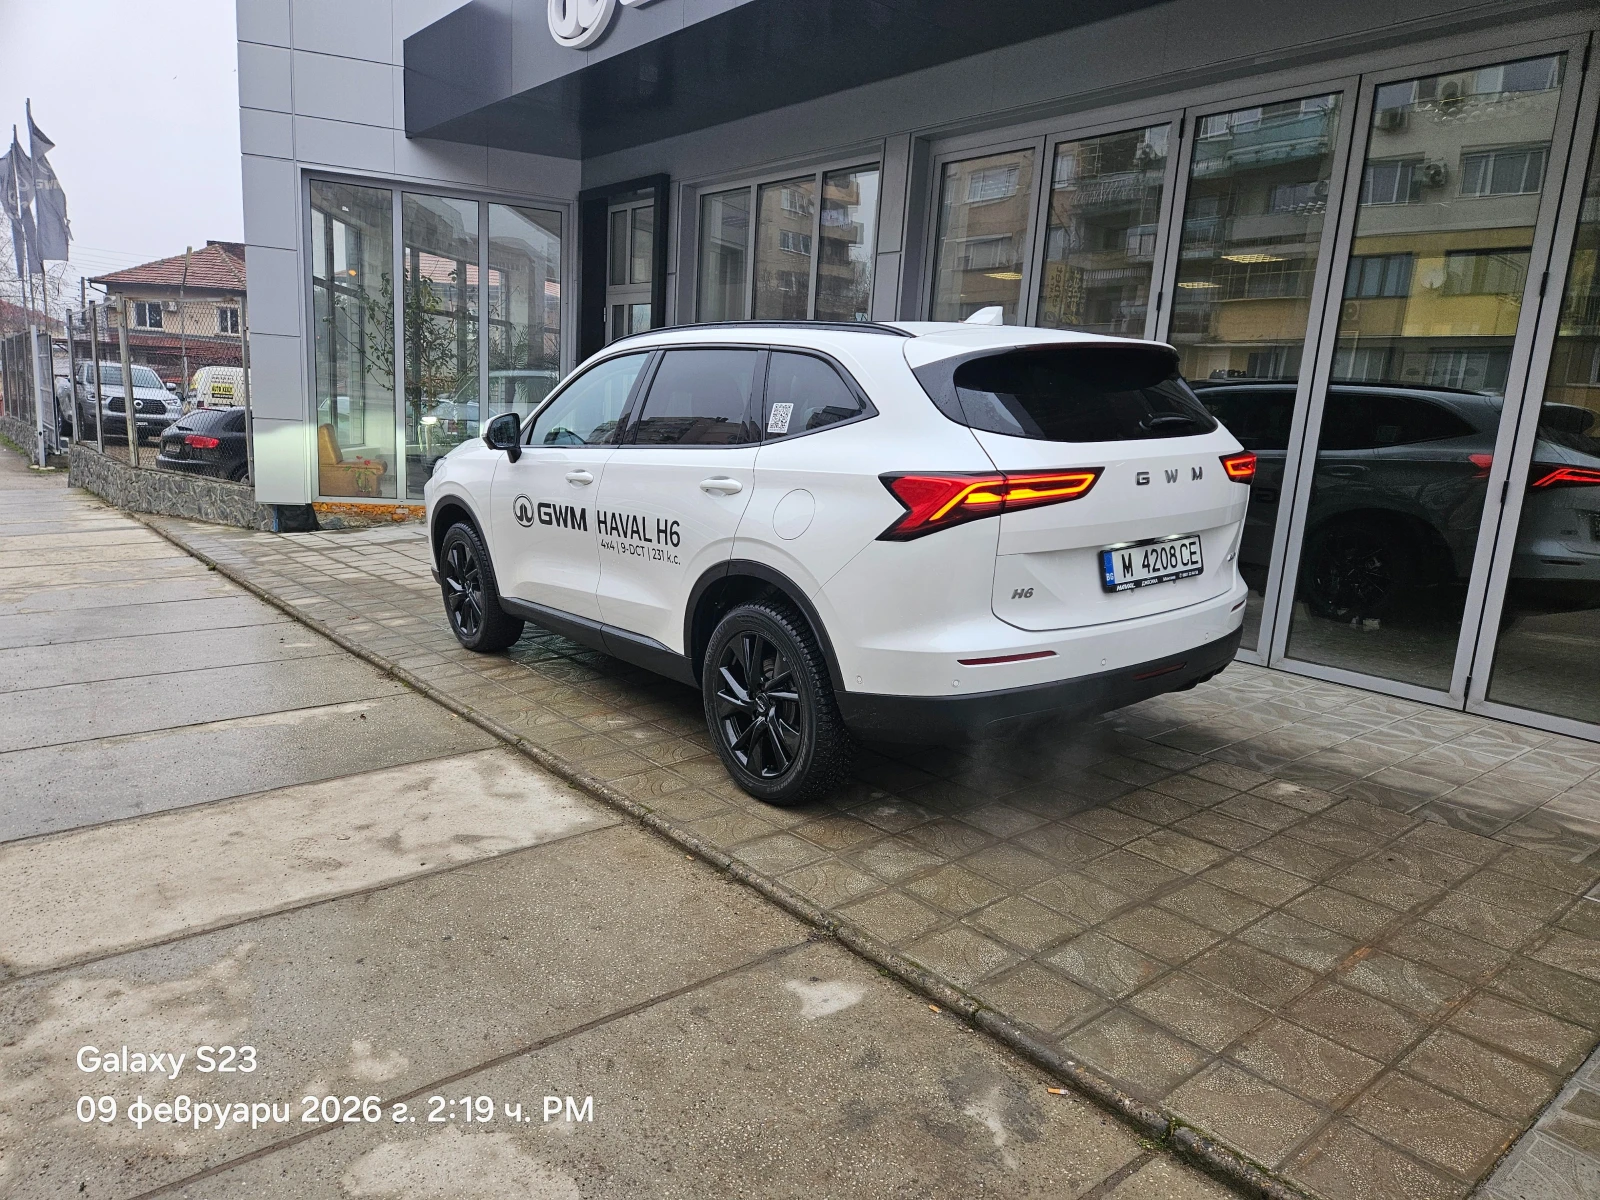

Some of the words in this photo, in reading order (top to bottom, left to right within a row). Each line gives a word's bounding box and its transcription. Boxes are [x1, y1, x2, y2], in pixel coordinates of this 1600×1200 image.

[537, 502, 588, 532] GWM
[597, 510, 653, 543] HAVAL
[656, 518, 681, 548] H6
[620, 542, 646, 558] 9-DCT
[652, 548, 665, 562] 231
[1121, 552, 1134, 578] M
[1142, 545, 1178, 574] 4208
[1180, 541, 1199, 566] CE
[1106, 572, 1114, 581] BG
[1011, 588, 1034, 599] H6
